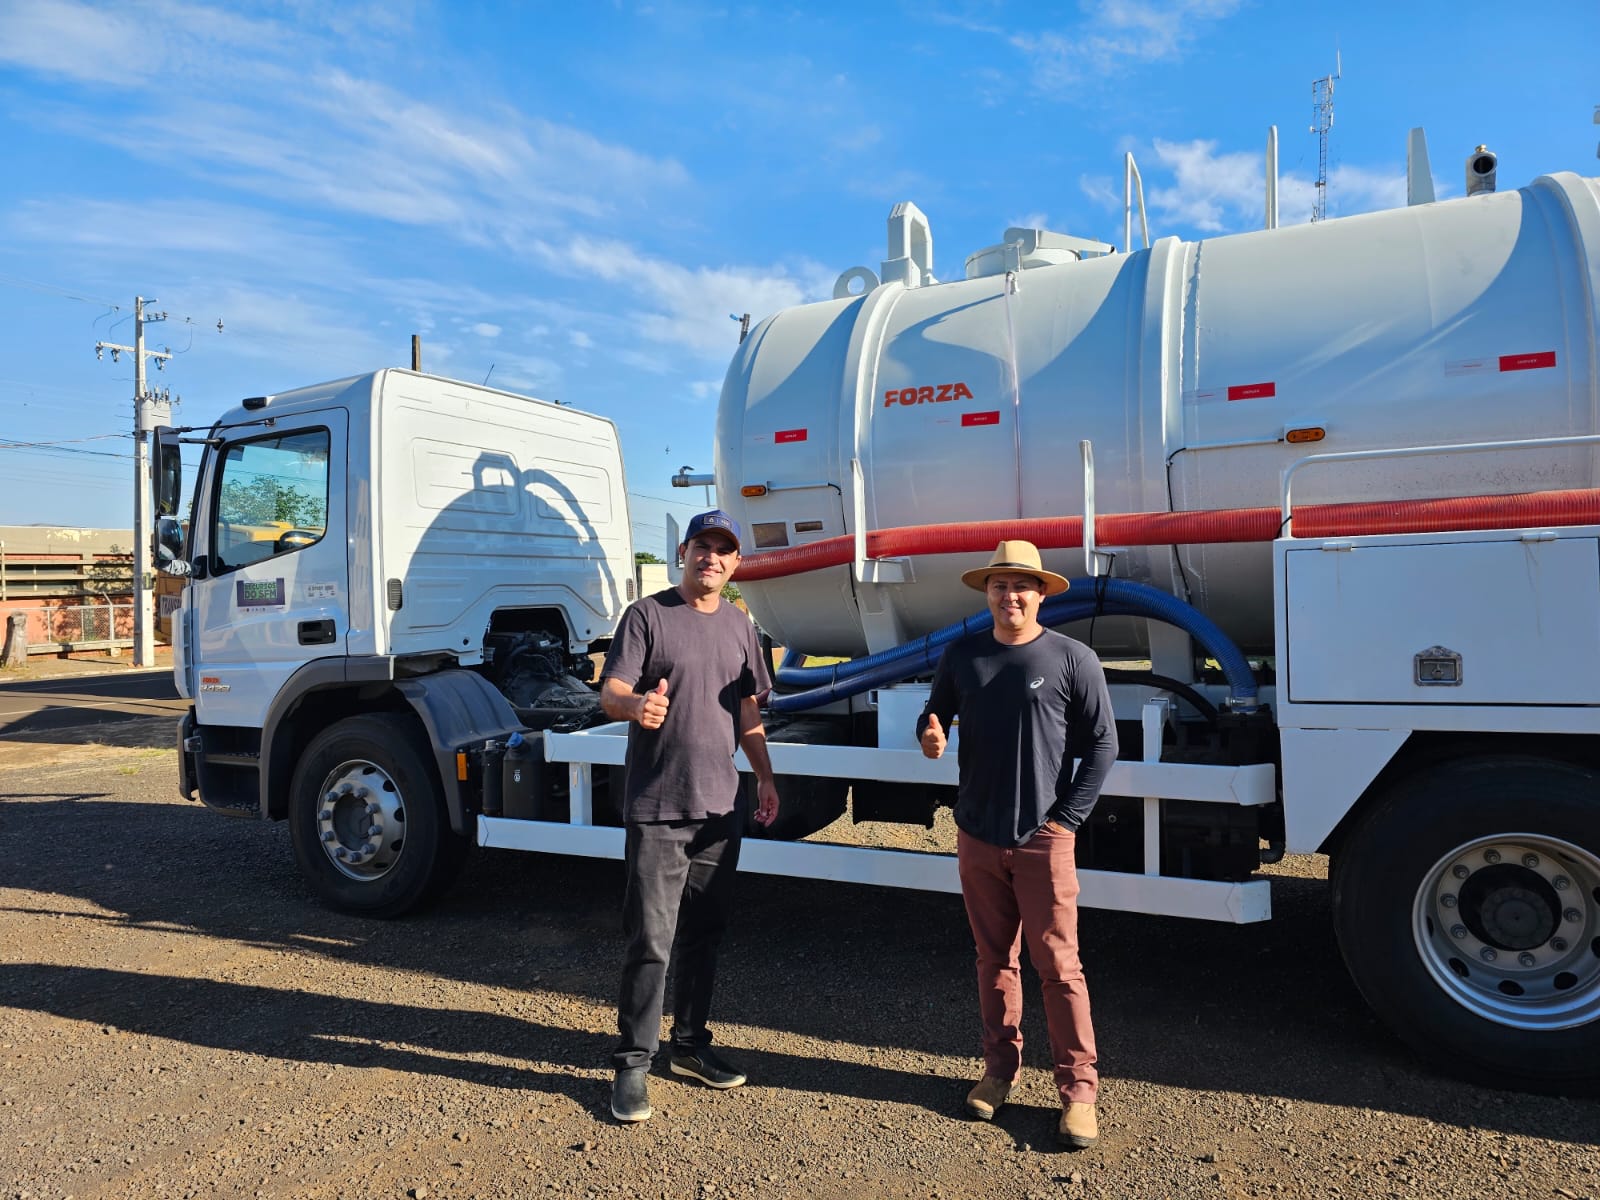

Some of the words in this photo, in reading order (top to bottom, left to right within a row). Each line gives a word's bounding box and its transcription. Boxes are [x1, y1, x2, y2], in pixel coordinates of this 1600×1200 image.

[884, 382, 974, 408] FORZA
[244, 582, 277, 590] RECURSOS
[244, 590, 257, 600] DO
[258, 589, 277, 600] SFM
